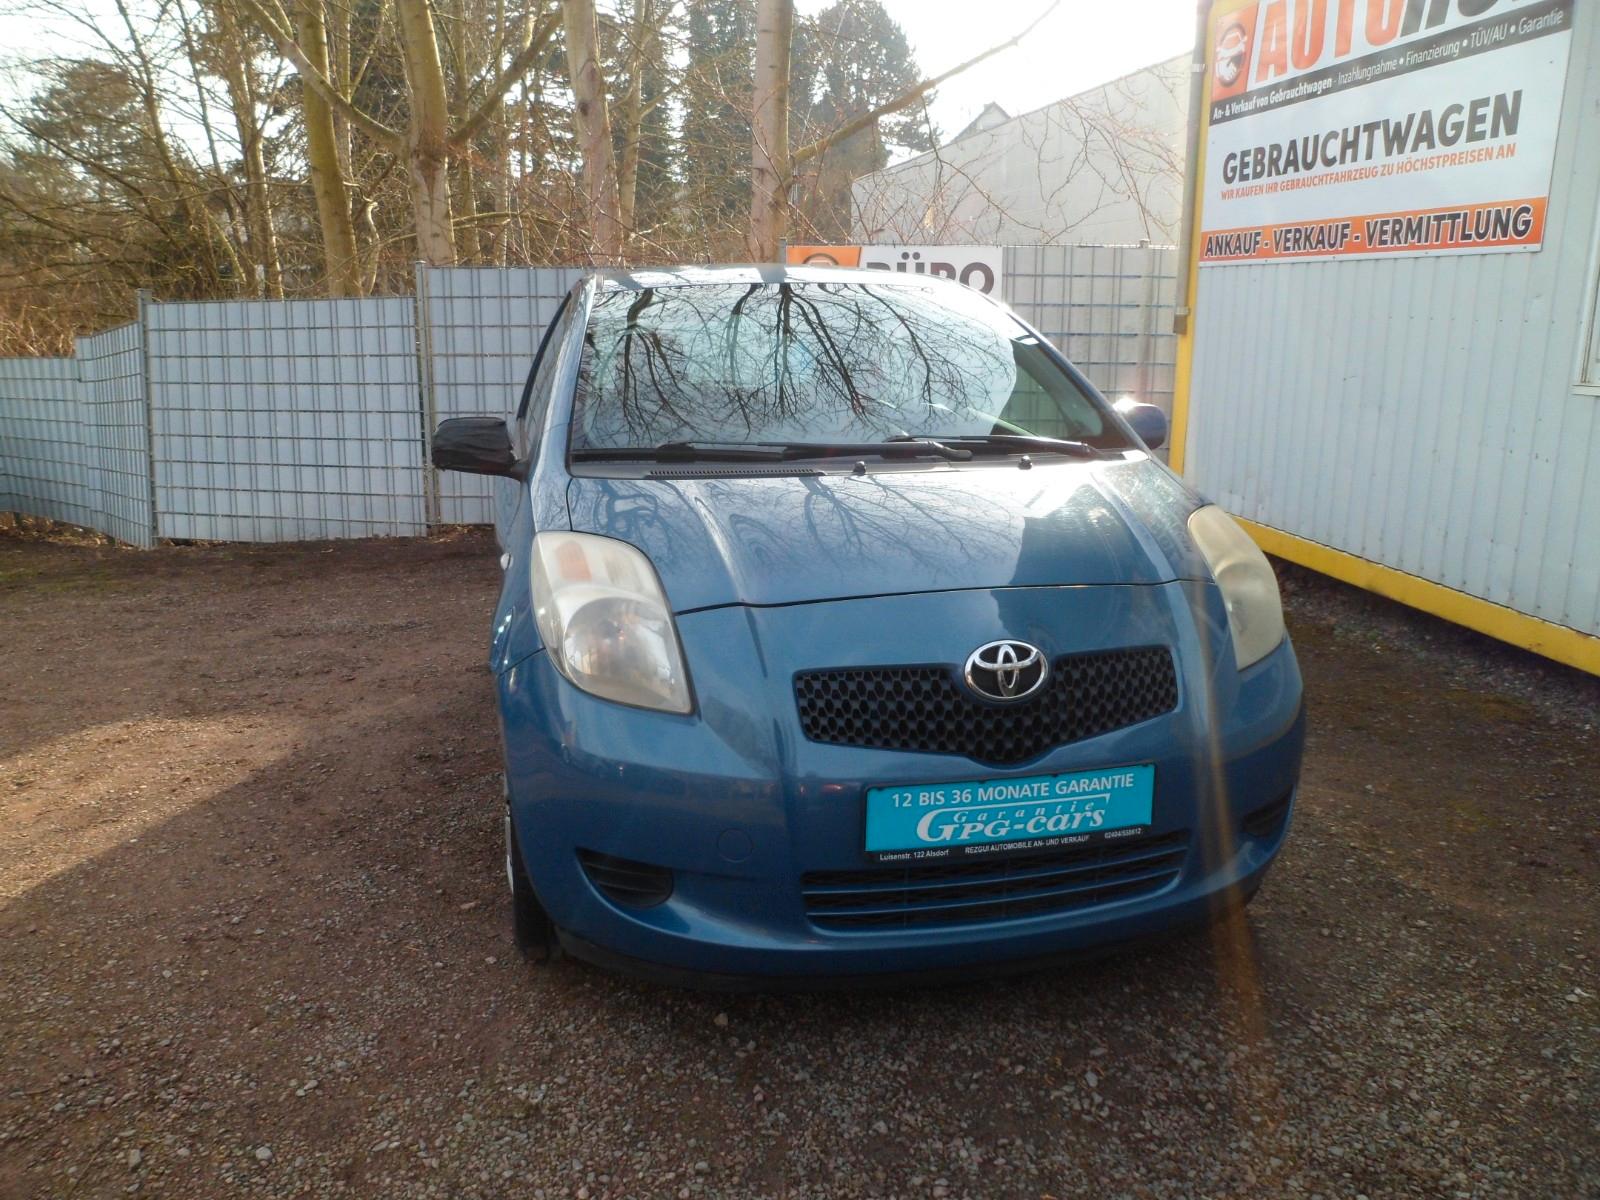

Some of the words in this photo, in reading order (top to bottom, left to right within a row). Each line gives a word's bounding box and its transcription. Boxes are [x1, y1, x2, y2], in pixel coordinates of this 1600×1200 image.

[1231, 96, 1257, 115] Verkauf
[1256, 97, 1269, 108] von
[1270, 77, 1333, 105] Gebrauchtwagen
[1338, 58, 1398, 86] Inzahlungnahme
[1406, 41, 1460, 67] Finanzierung
[1470, 24, 1508, 49] TÜV/AU
[1518, 7, 1564, 35] Garantie
[1222, 90, 1523, 184] GEBRAUCHTWAGEN
[1221, 188, 1234, 201] WIR
[1235, 184, 1264, 199] KAUFEN
[1266, 182, 1278, 193] IHR
[1279, 166, 1379, 192] GEBRAUCHTFAHRZEUG
[1380, 163, 1394, 177] ZU
[1396, 146, 1494, 175] HÖCHSTPREISEN
[1496, 143, 1517, 160] AN
[1203, 230, 1262, 259] ANKAUF
[1272, 222, 1351, 255] VERKAUF
[1365, 204, 1533, 248] VERMITTLUNG
[866, 251, 995, 296] ÜO
[891, 792, 913, 808] 12
[918, 790, 946, 807] BIS
[951, 788, 973, 804] 36
[977, 782, 1050, 801] MONATE
[1055, 773, 1135, 795] GARANTIE
[926, 848, 950, 858] Alsdorf
[990, 838, 1033, 852] AUTOMOBILE
[1046, 837, 1060, 846] UND
[1060, 834, 1091, 845] VERKAUF
